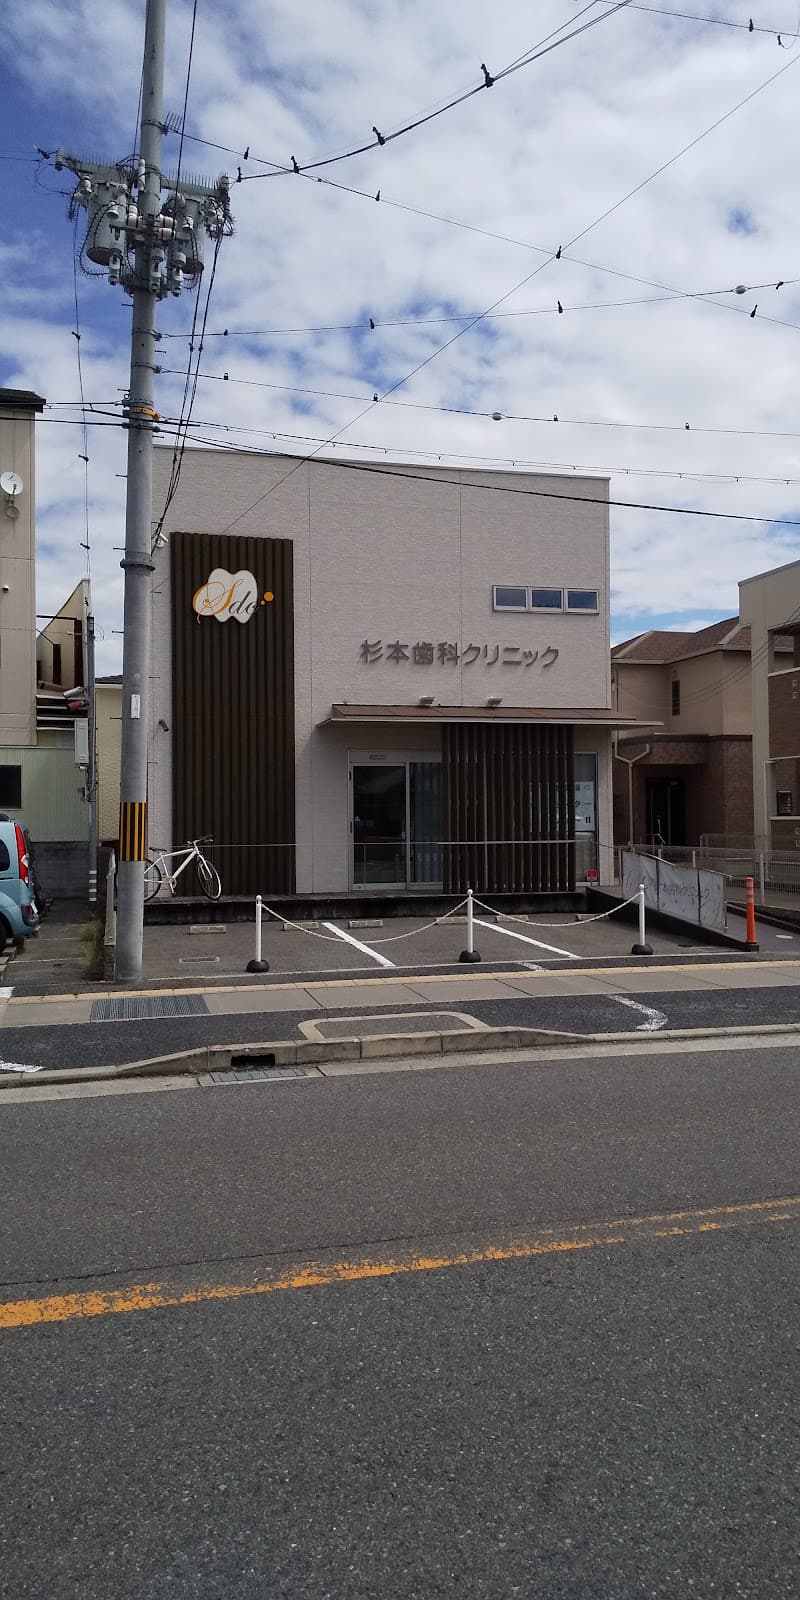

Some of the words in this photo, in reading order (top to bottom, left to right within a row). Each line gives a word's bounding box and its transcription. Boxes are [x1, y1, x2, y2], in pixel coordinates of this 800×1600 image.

[359, 639, 560, 667] 杉本歯科クリニック
